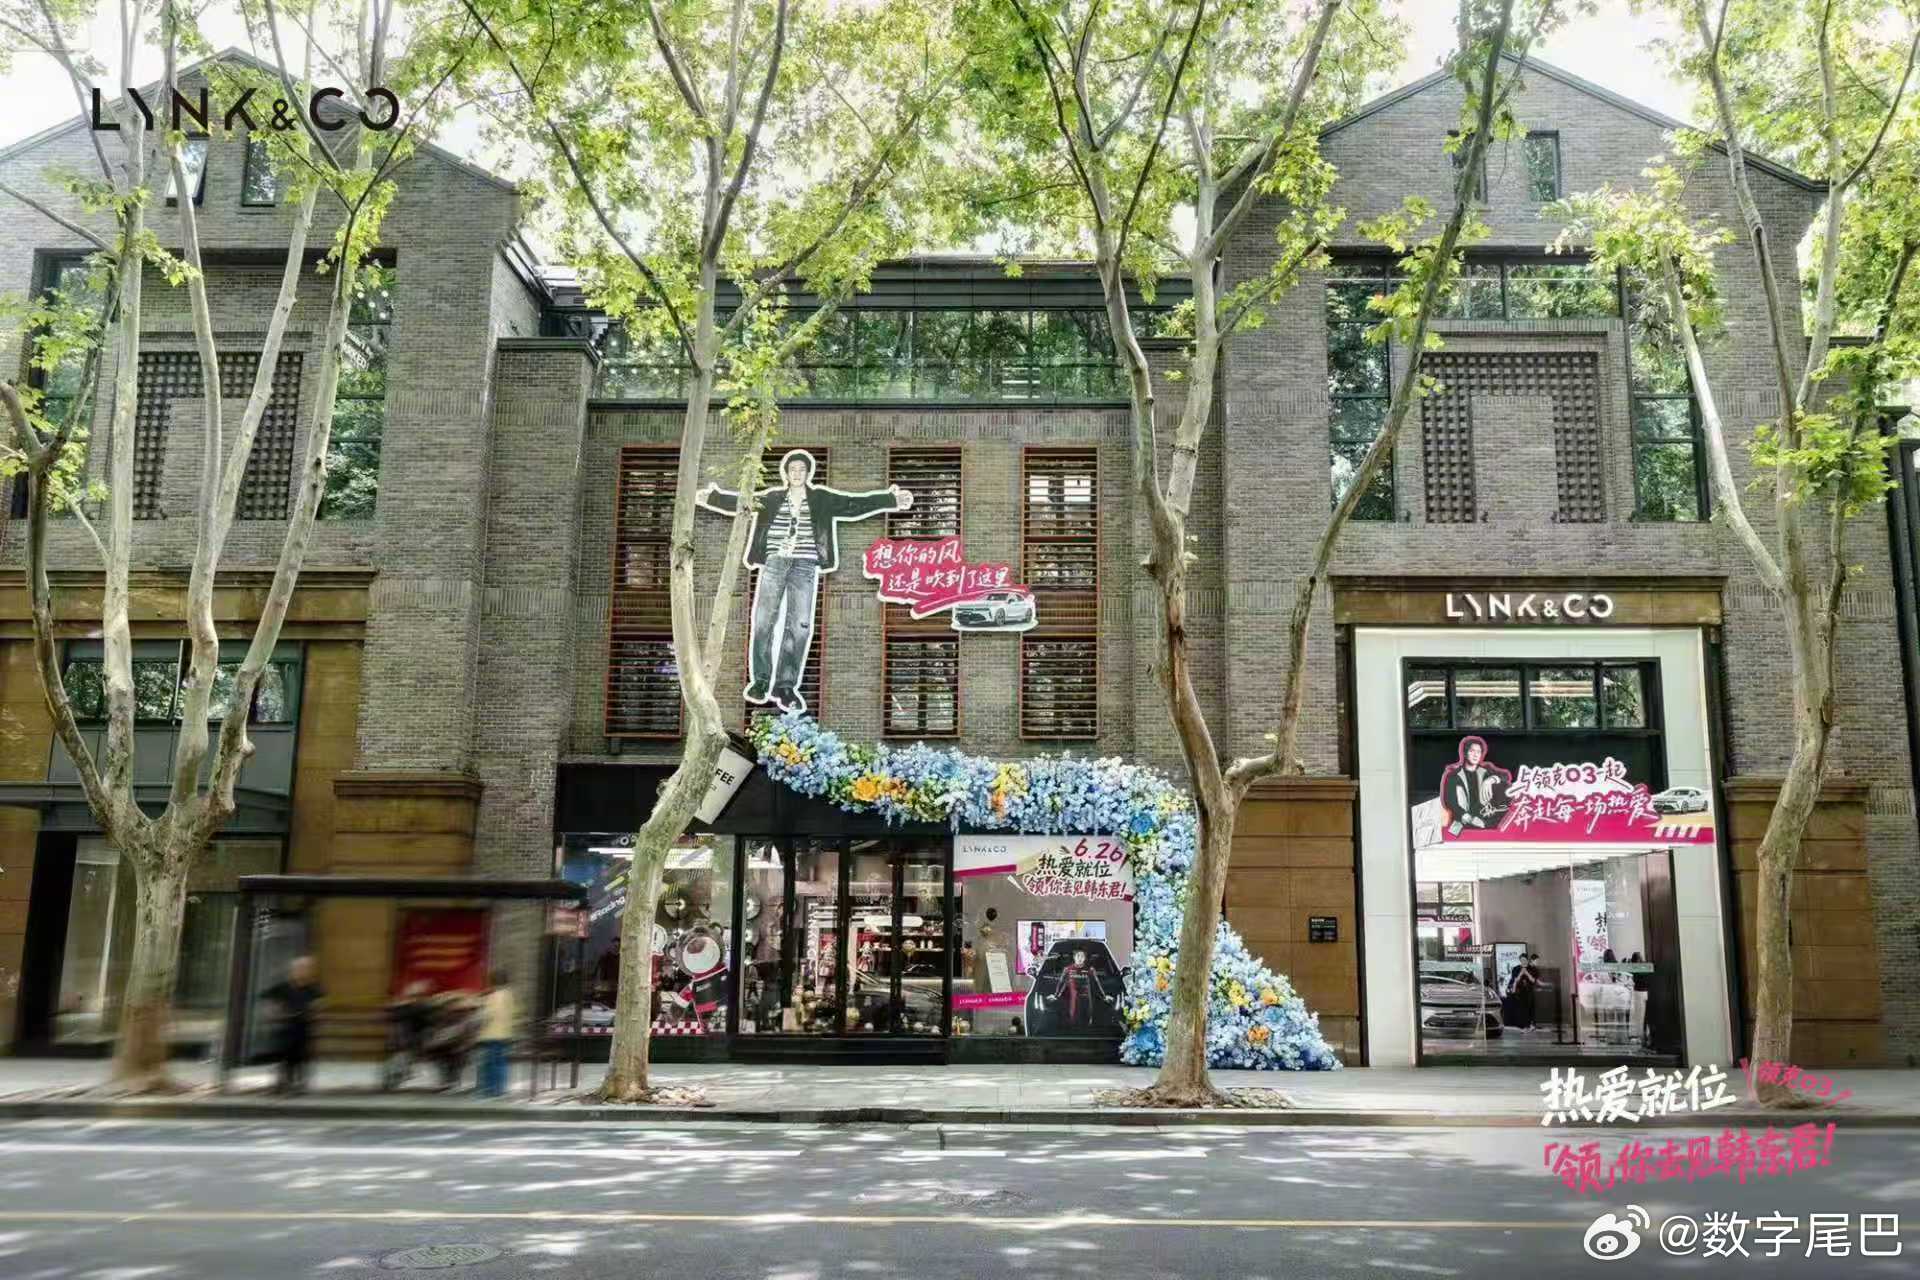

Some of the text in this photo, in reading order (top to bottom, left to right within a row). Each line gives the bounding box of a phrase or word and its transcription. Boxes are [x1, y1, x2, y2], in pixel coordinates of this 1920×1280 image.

[872, 540, 962, 569] 想你的风
[888, 566, 1013, 596] 还是吹到了这里
[1500, 785, 1660, 834] 奔赴每一场热爱
[1074, 837, 1124, 862] 6.26
[1037, 854, 1113, 879] 热爱就位
